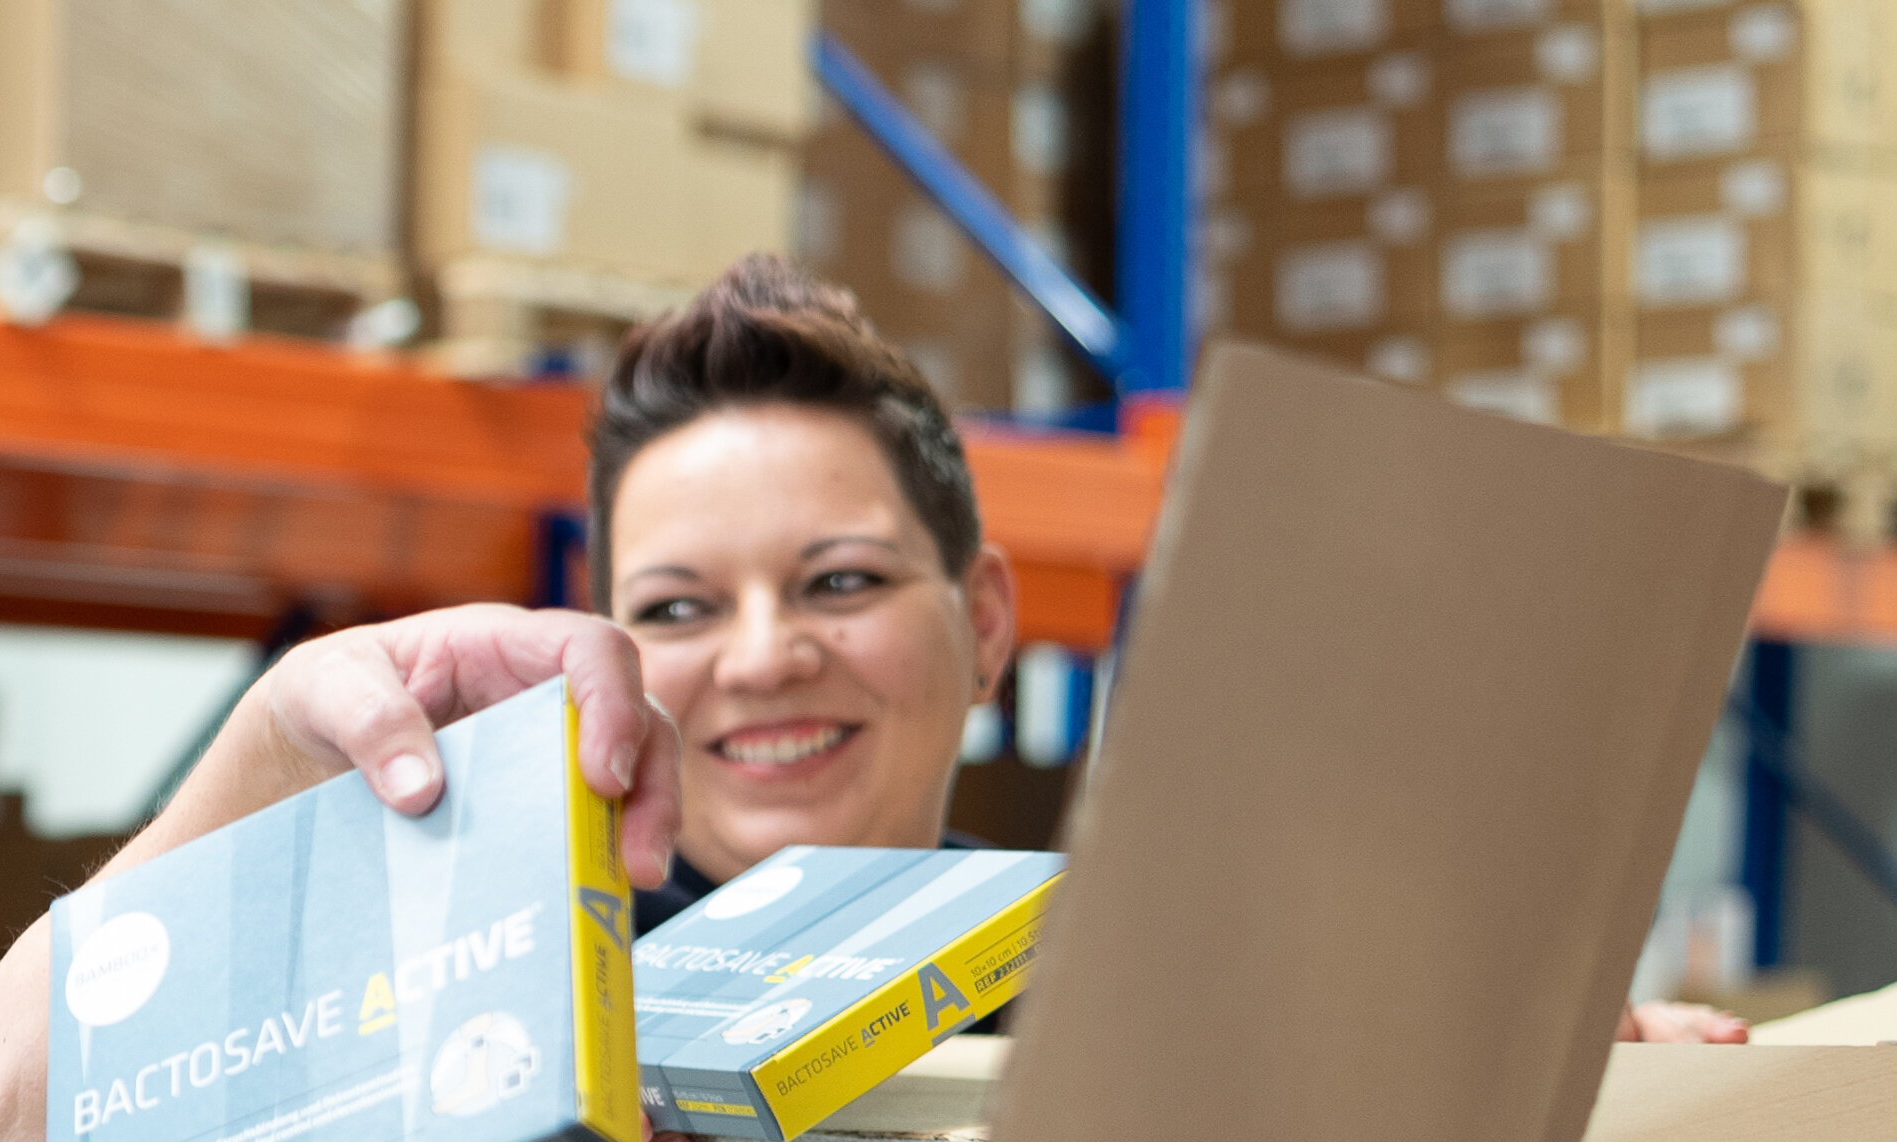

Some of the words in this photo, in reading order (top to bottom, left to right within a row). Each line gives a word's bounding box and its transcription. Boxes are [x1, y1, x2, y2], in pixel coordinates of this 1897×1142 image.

[73, 989, 344, 1135] BACTOSAVE
[358, 908, 537, 1036] ACTIVE
[776, 1035, 858, 1097] BACTOSAVE
[859, 1002, 911, 1048] ACTIVE
[917, 961, 976, 1047] A
